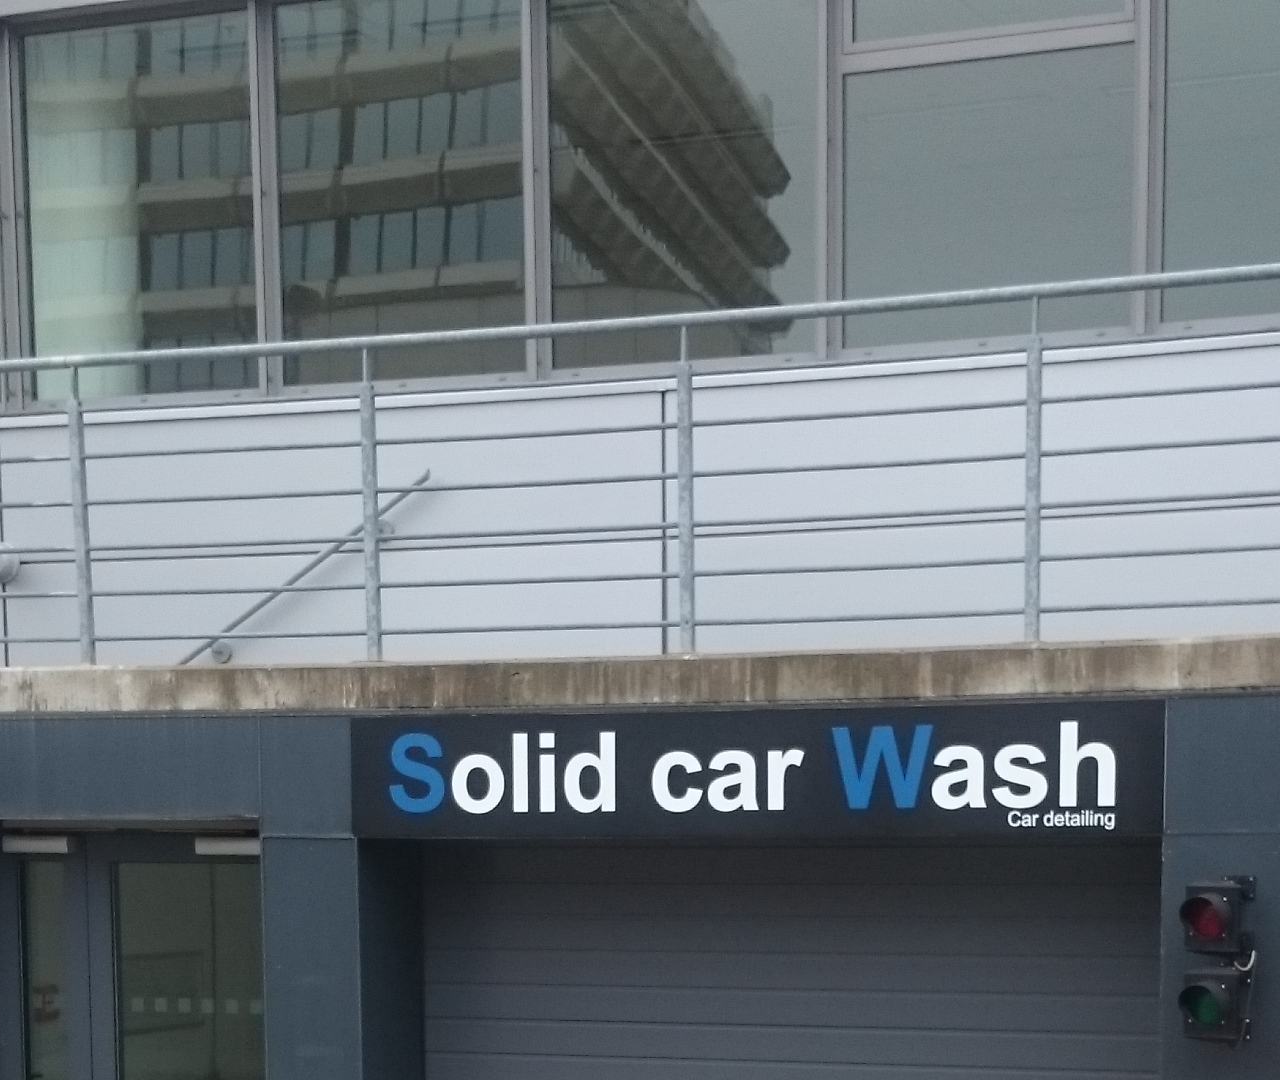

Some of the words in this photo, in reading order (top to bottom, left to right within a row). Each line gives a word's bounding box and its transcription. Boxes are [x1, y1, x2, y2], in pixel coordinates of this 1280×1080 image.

[389, 731, 616, 815] Solid
[651, 748, 805, 813] car
[832, 720, 1117, 810] Wash
[1007, 809, 1039, 827] Car
[1043, 809, 1115, 831] detailing
